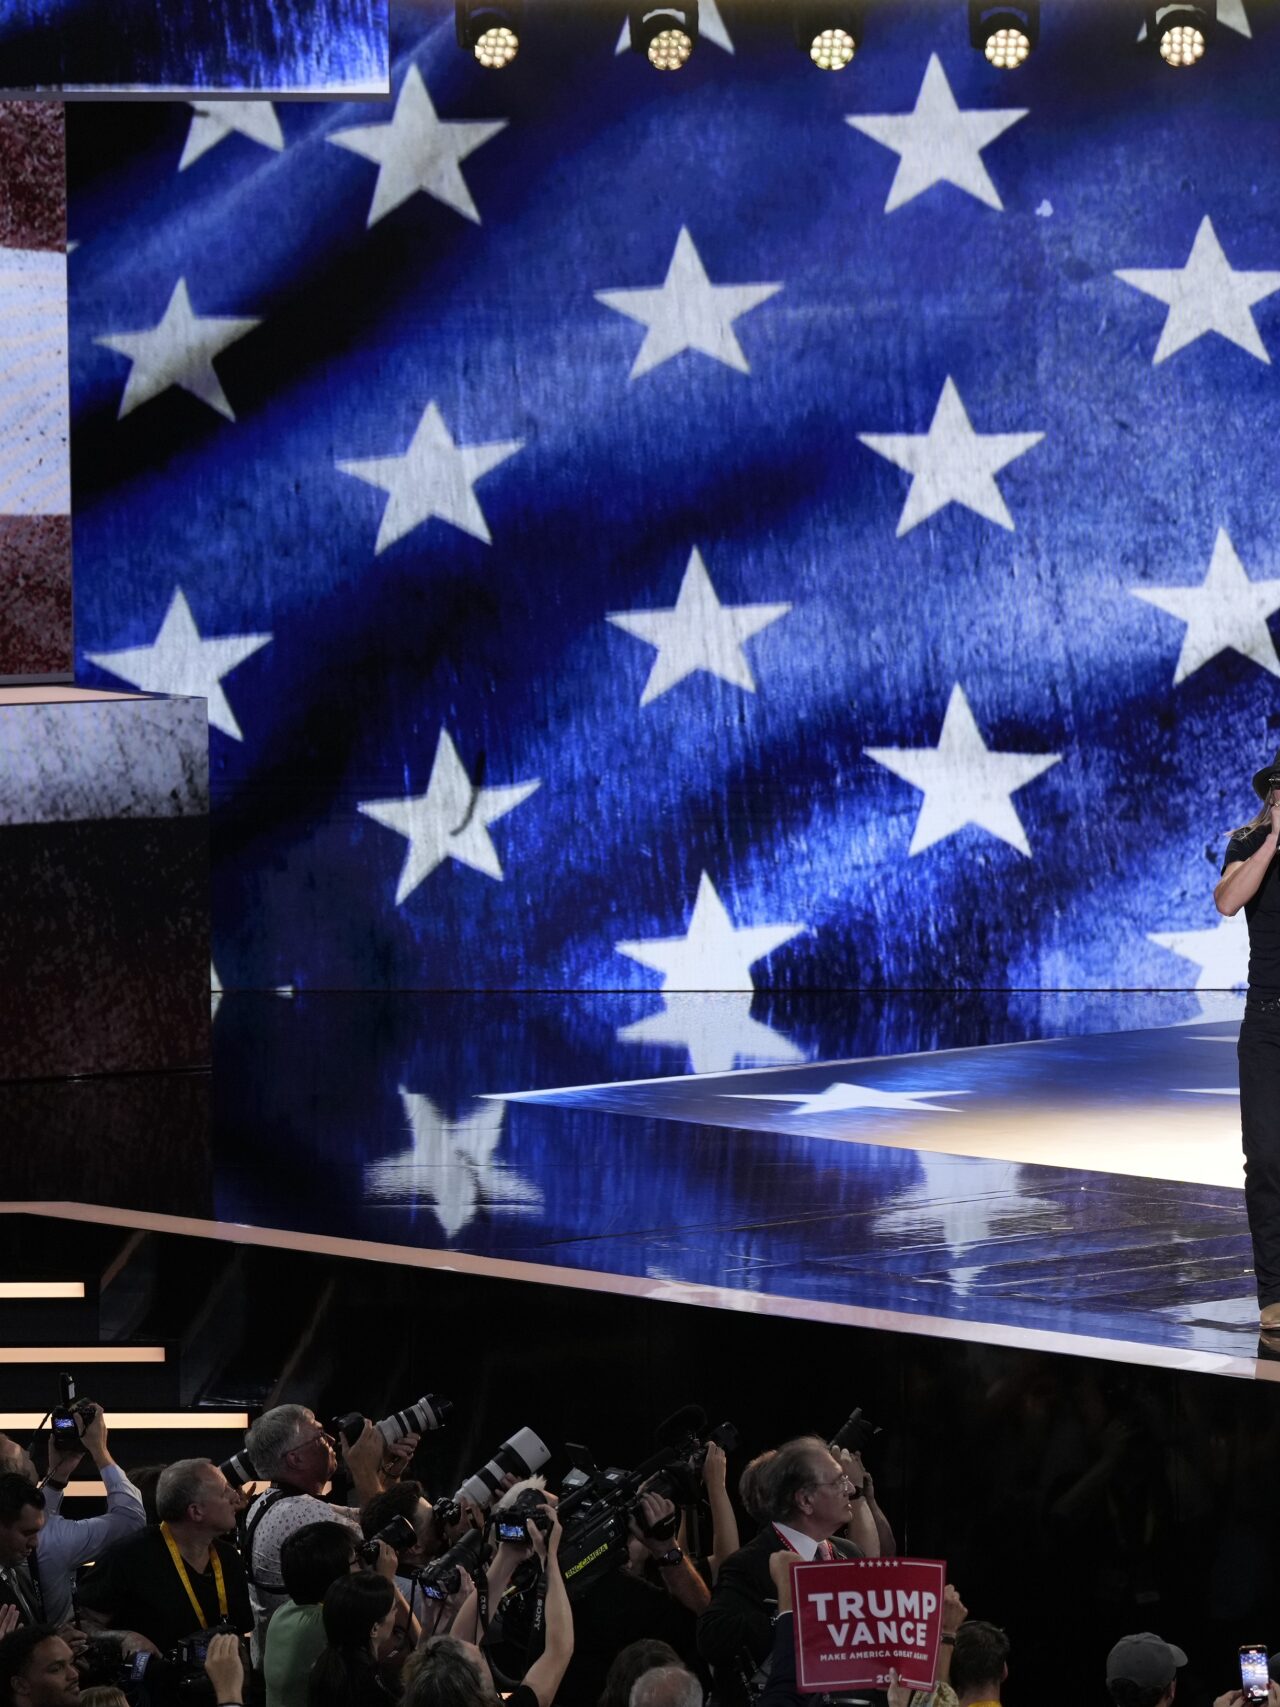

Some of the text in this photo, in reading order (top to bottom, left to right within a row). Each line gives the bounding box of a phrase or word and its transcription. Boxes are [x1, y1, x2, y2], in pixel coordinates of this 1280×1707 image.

[533, 1598, 543, 1631] SONY
[807, 1589, 937, 1621] TRUMP
[827, 1620, 928, 1648] VANCE
[820, 1653, 847, 1662] MAKE
[849, 1650, 891, 1660] AMERICA
[893, 1649, 913, 1659] GREAT
